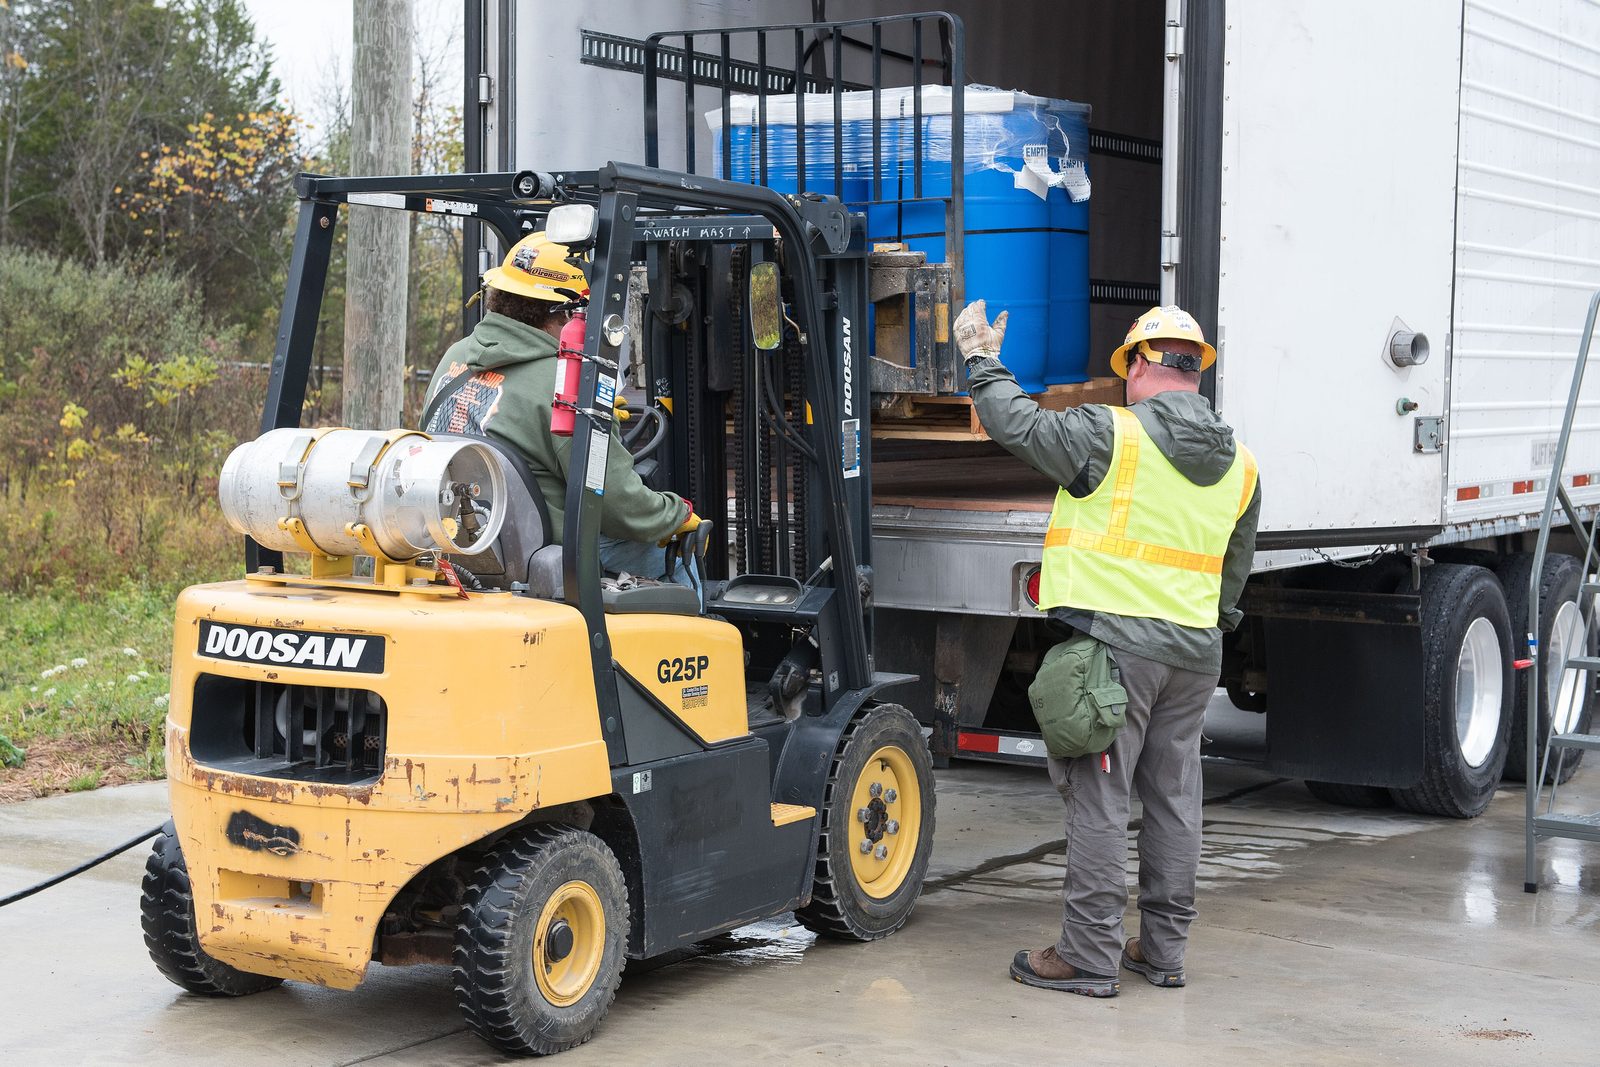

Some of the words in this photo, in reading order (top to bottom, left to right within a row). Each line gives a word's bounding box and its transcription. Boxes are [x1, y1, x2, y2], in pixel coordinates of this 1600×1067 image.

[653, 226, 690, 238] WATCH
[700, 227, 734, 238] MAST
[1144, 321, 1160, 331] EH
[842, 316, 853, 417] DOOSAN
[204, 624, 368, 669] DOOSAN
[657, 655, 709, 684] G25P
[1033, 698, 1044, 709] US
